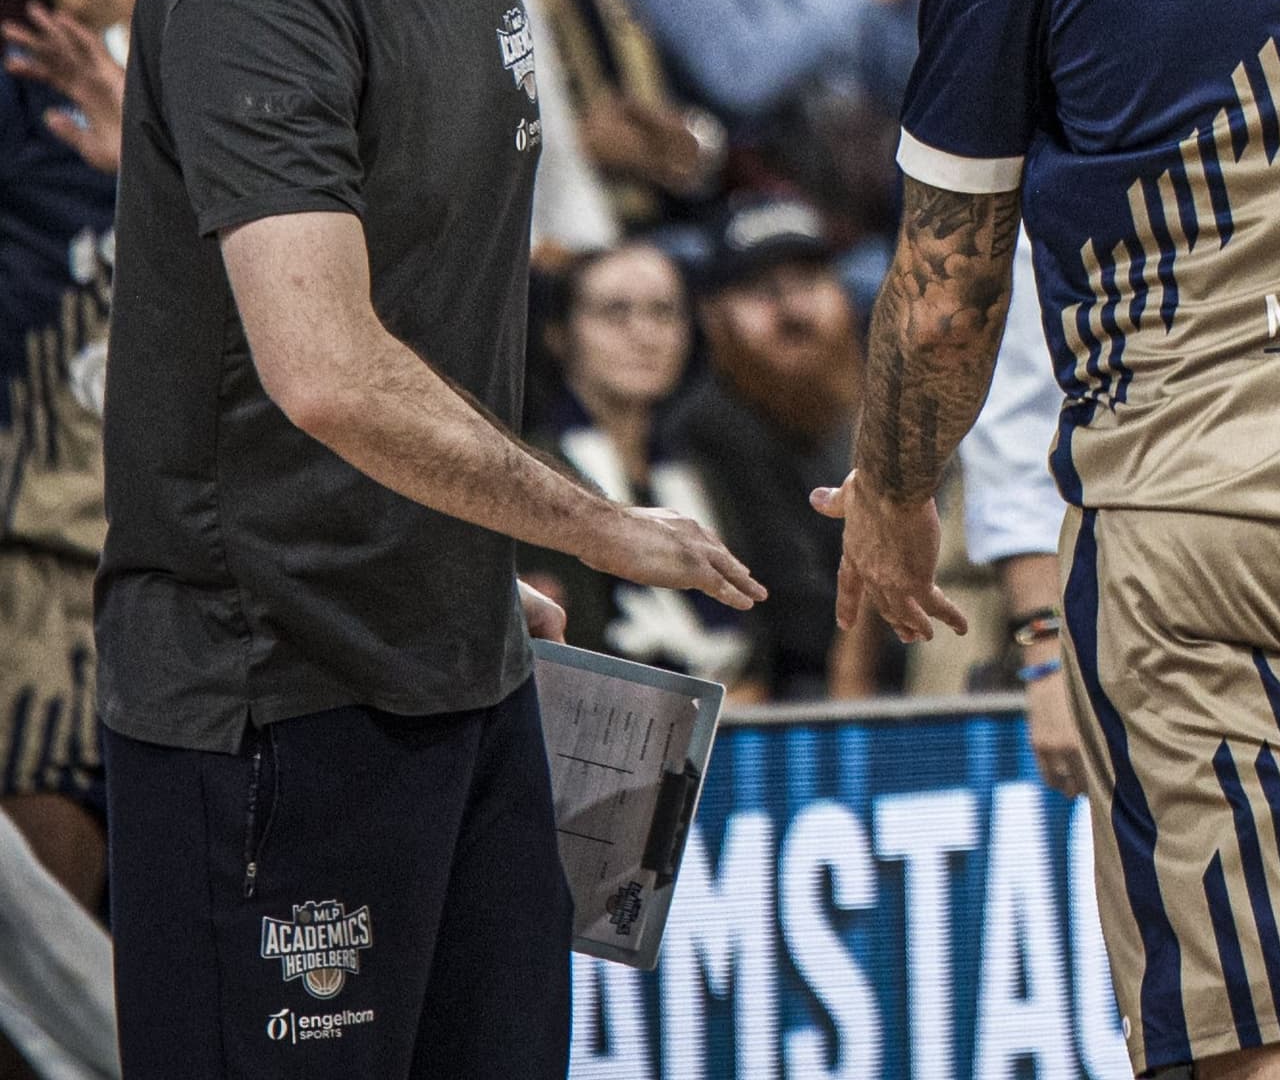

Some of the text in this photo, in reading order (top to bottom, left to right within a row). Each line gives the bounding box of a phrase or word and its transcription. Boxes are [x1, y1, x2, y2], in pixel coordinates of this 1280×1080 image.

[314, 908, 340, 922] MLP
[266, 913, 369, 955] ACADEMICS
[285, 949, 357, 977] HEIDELBERG
[300, 1010, 374, 1030] engelhorn
[300, 1029, 342, 1041] SPORTS
